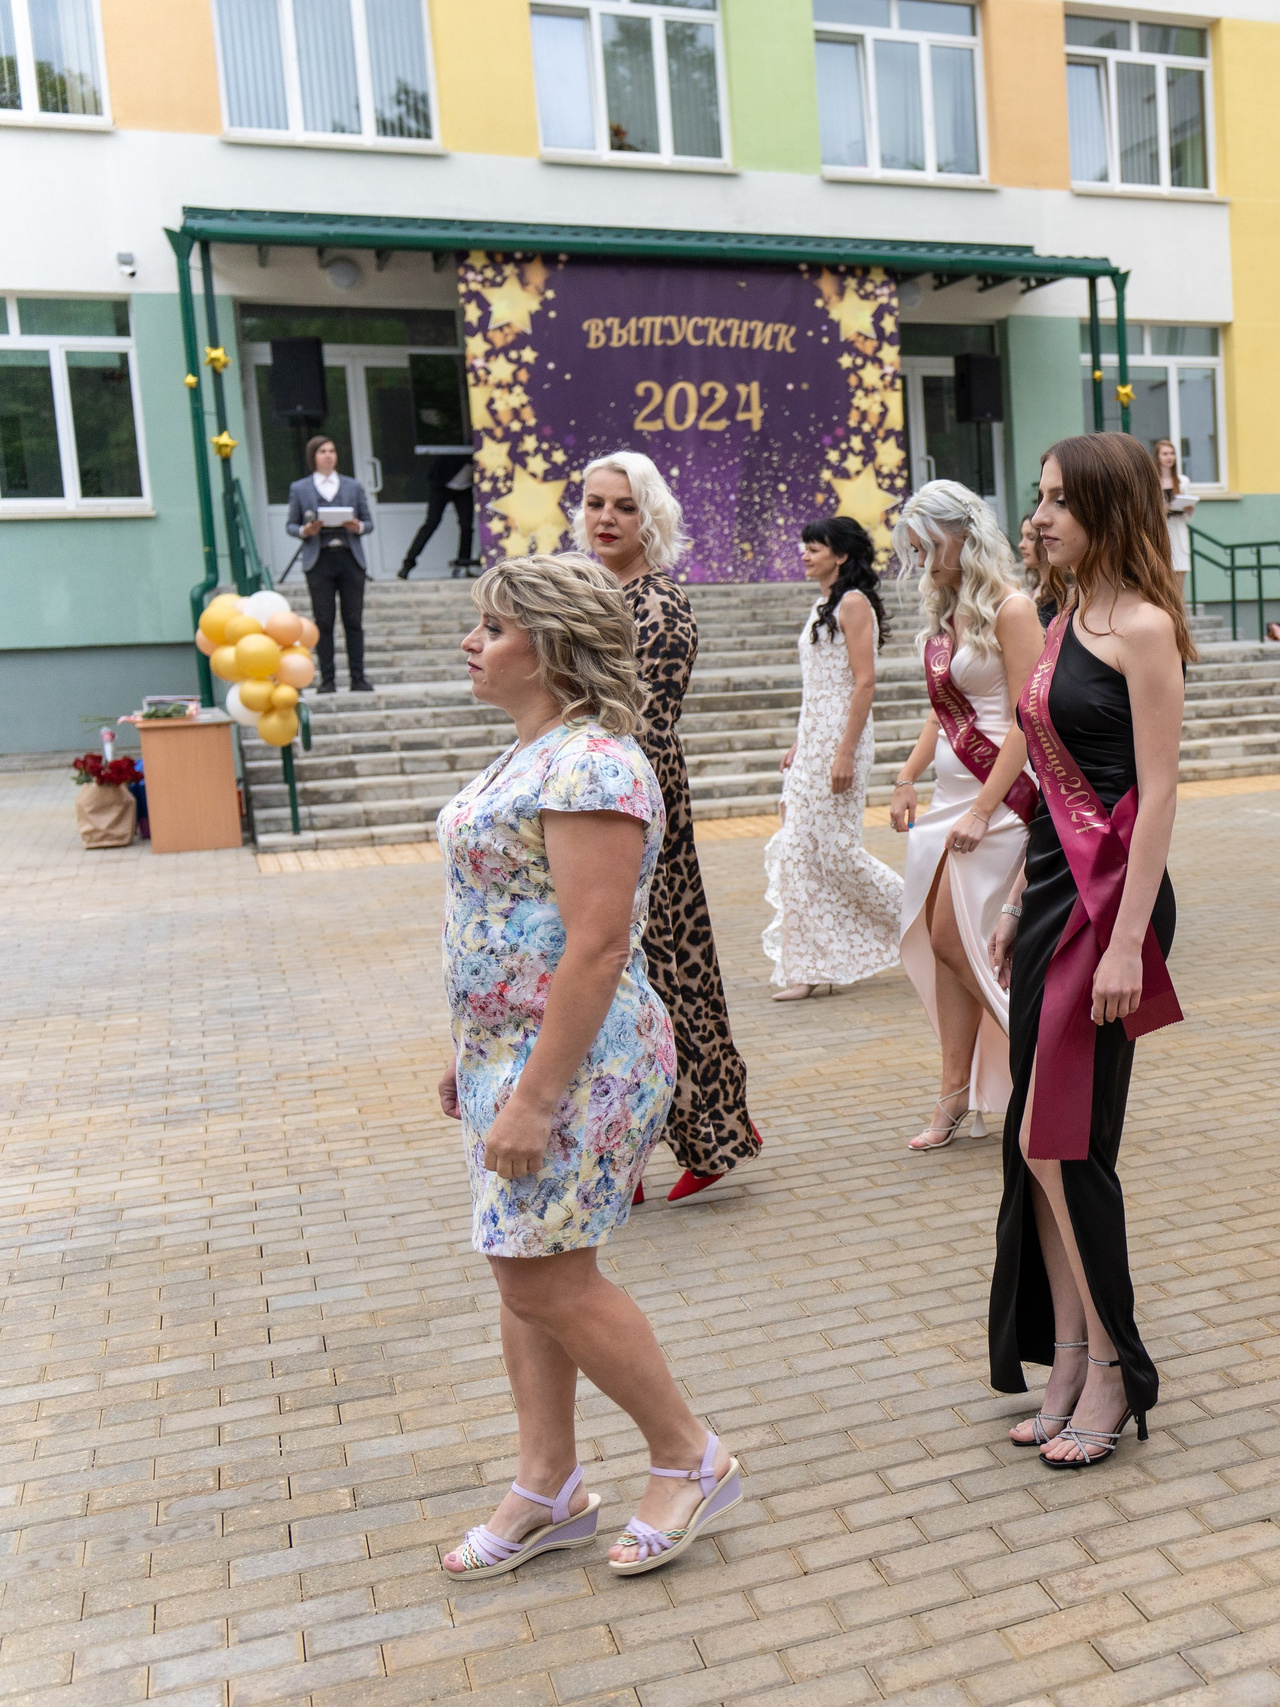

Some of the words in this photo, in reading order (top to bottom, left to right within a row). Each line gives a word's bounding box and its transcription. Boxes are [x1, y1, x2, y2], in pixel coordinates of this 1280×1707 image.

[581, 315, 798, 354] ВЫПУСКНИК
[633, 380, 765, 433] 2024
[1023, 637, 1067, 781] Выпускница
[1057, 777, 1105, 834] 2024
